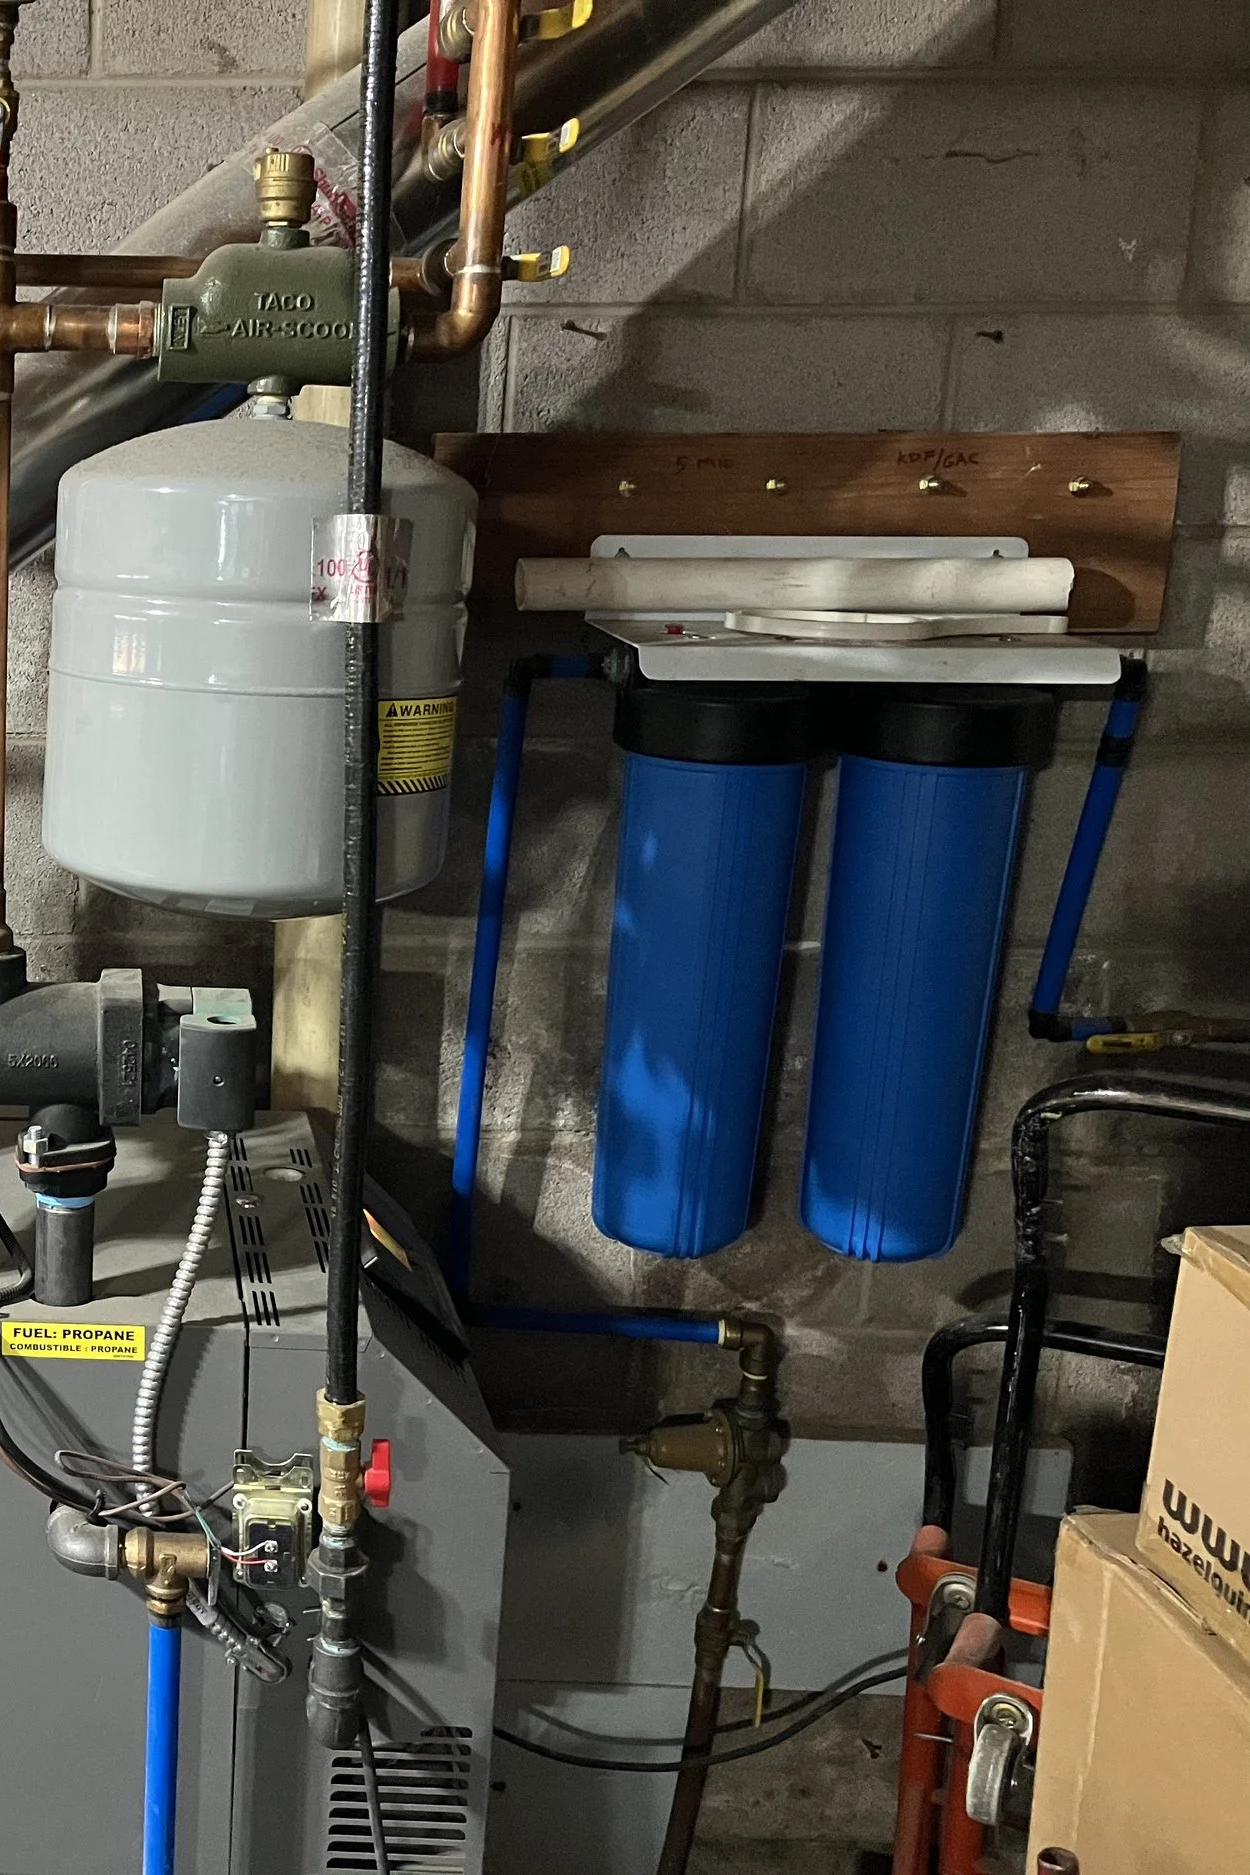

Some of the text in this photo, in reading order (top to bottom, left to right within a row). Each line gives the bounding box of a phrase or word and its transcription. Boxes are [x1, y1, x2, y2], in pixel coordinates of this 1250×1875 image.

[254, 292, 315, 312] TACO
[231, 319, 354, 339] AIR-SCOO
[400, 701, 454, 716] WARNING
[13, 1327, 135, 1341] FUEL: PROPANE
[9, 1343, 82, 1352] COMBUSTIBLE
[90, 1345, 138, 1354] PROPANE
